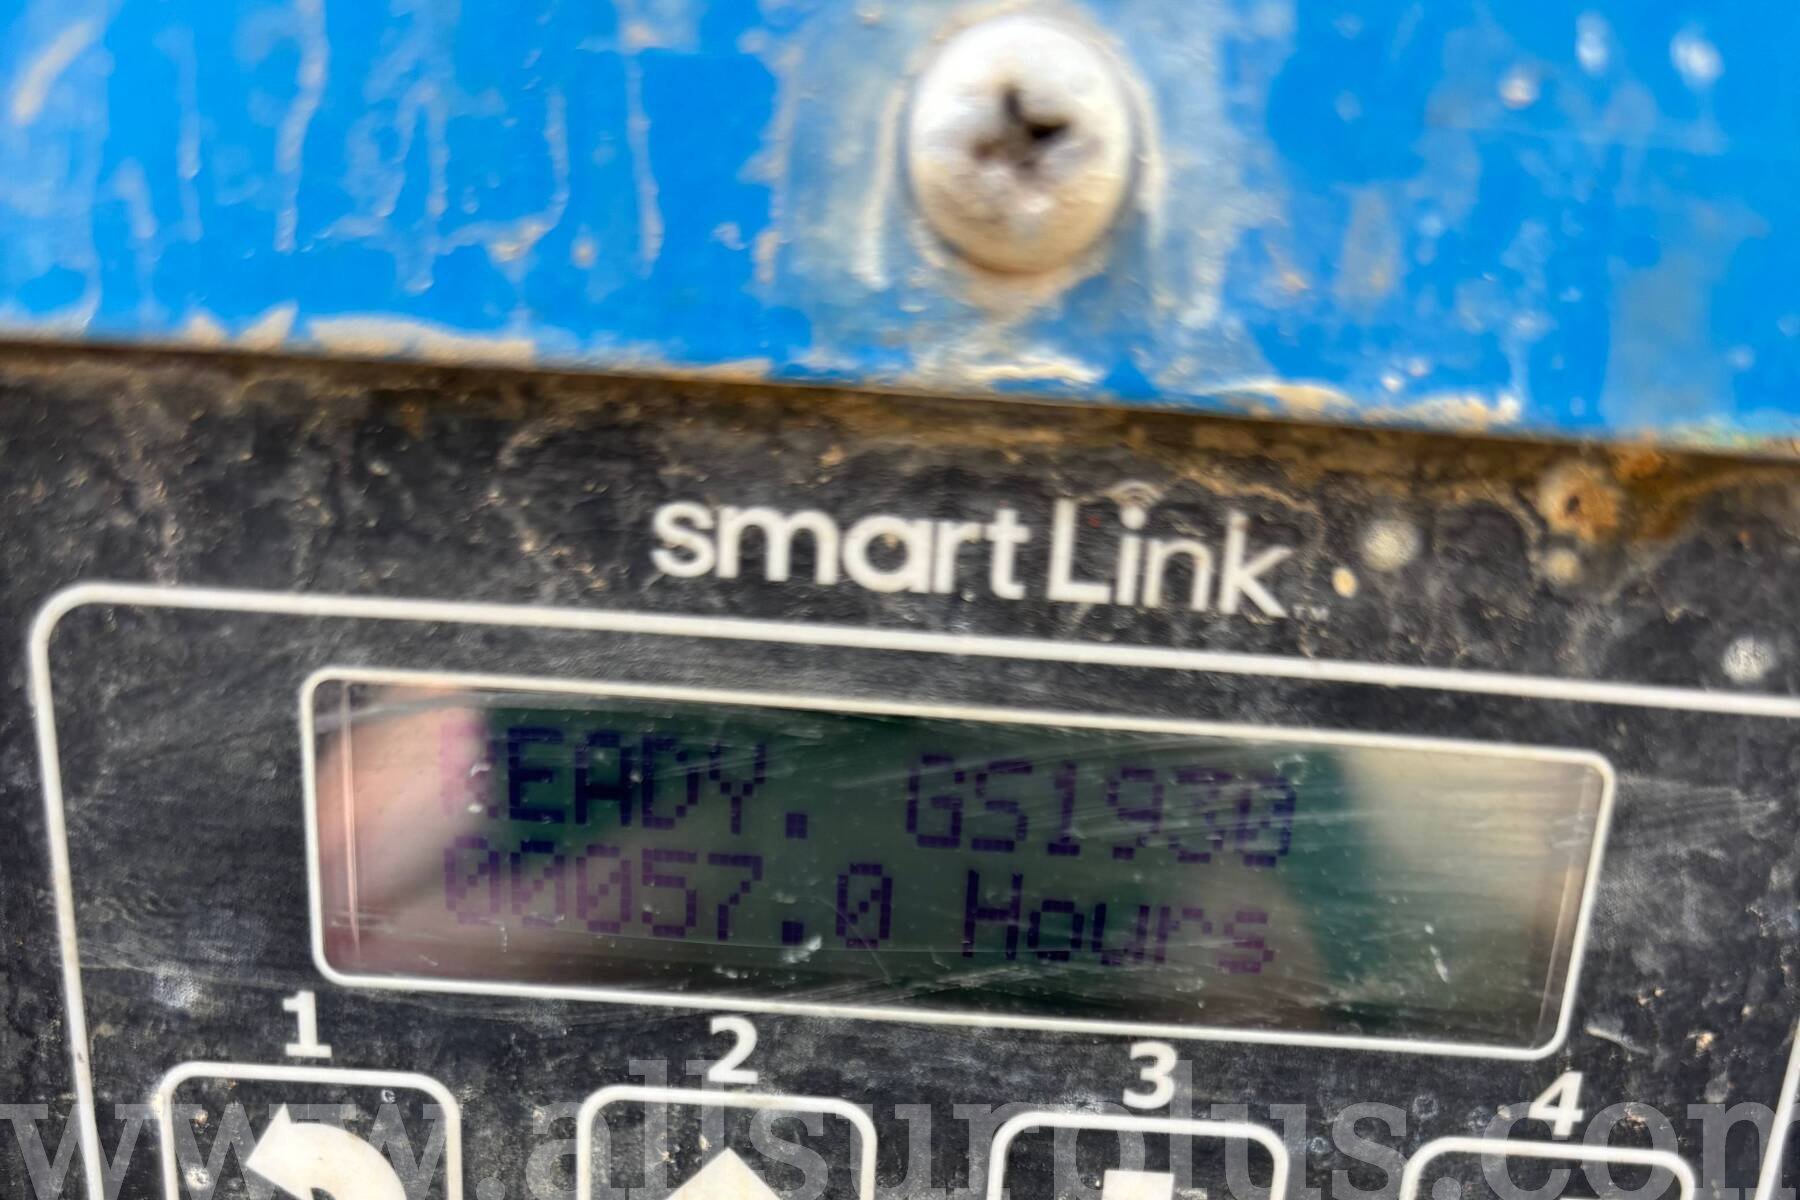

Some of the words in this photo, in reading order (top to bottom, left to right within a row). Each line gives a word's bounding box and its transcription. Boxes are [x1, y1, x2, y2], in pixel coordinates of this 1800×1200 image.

[442, 835, 893, 948] 00057.0
[961, 868, 1276, 975] Hours
[281, 990, 332, 1058] 1
[706, 1015, 759, 1085] 2
[1121, 1041, 1179, 1110] 3
[1528, 1070, 1585, 1136] 4
